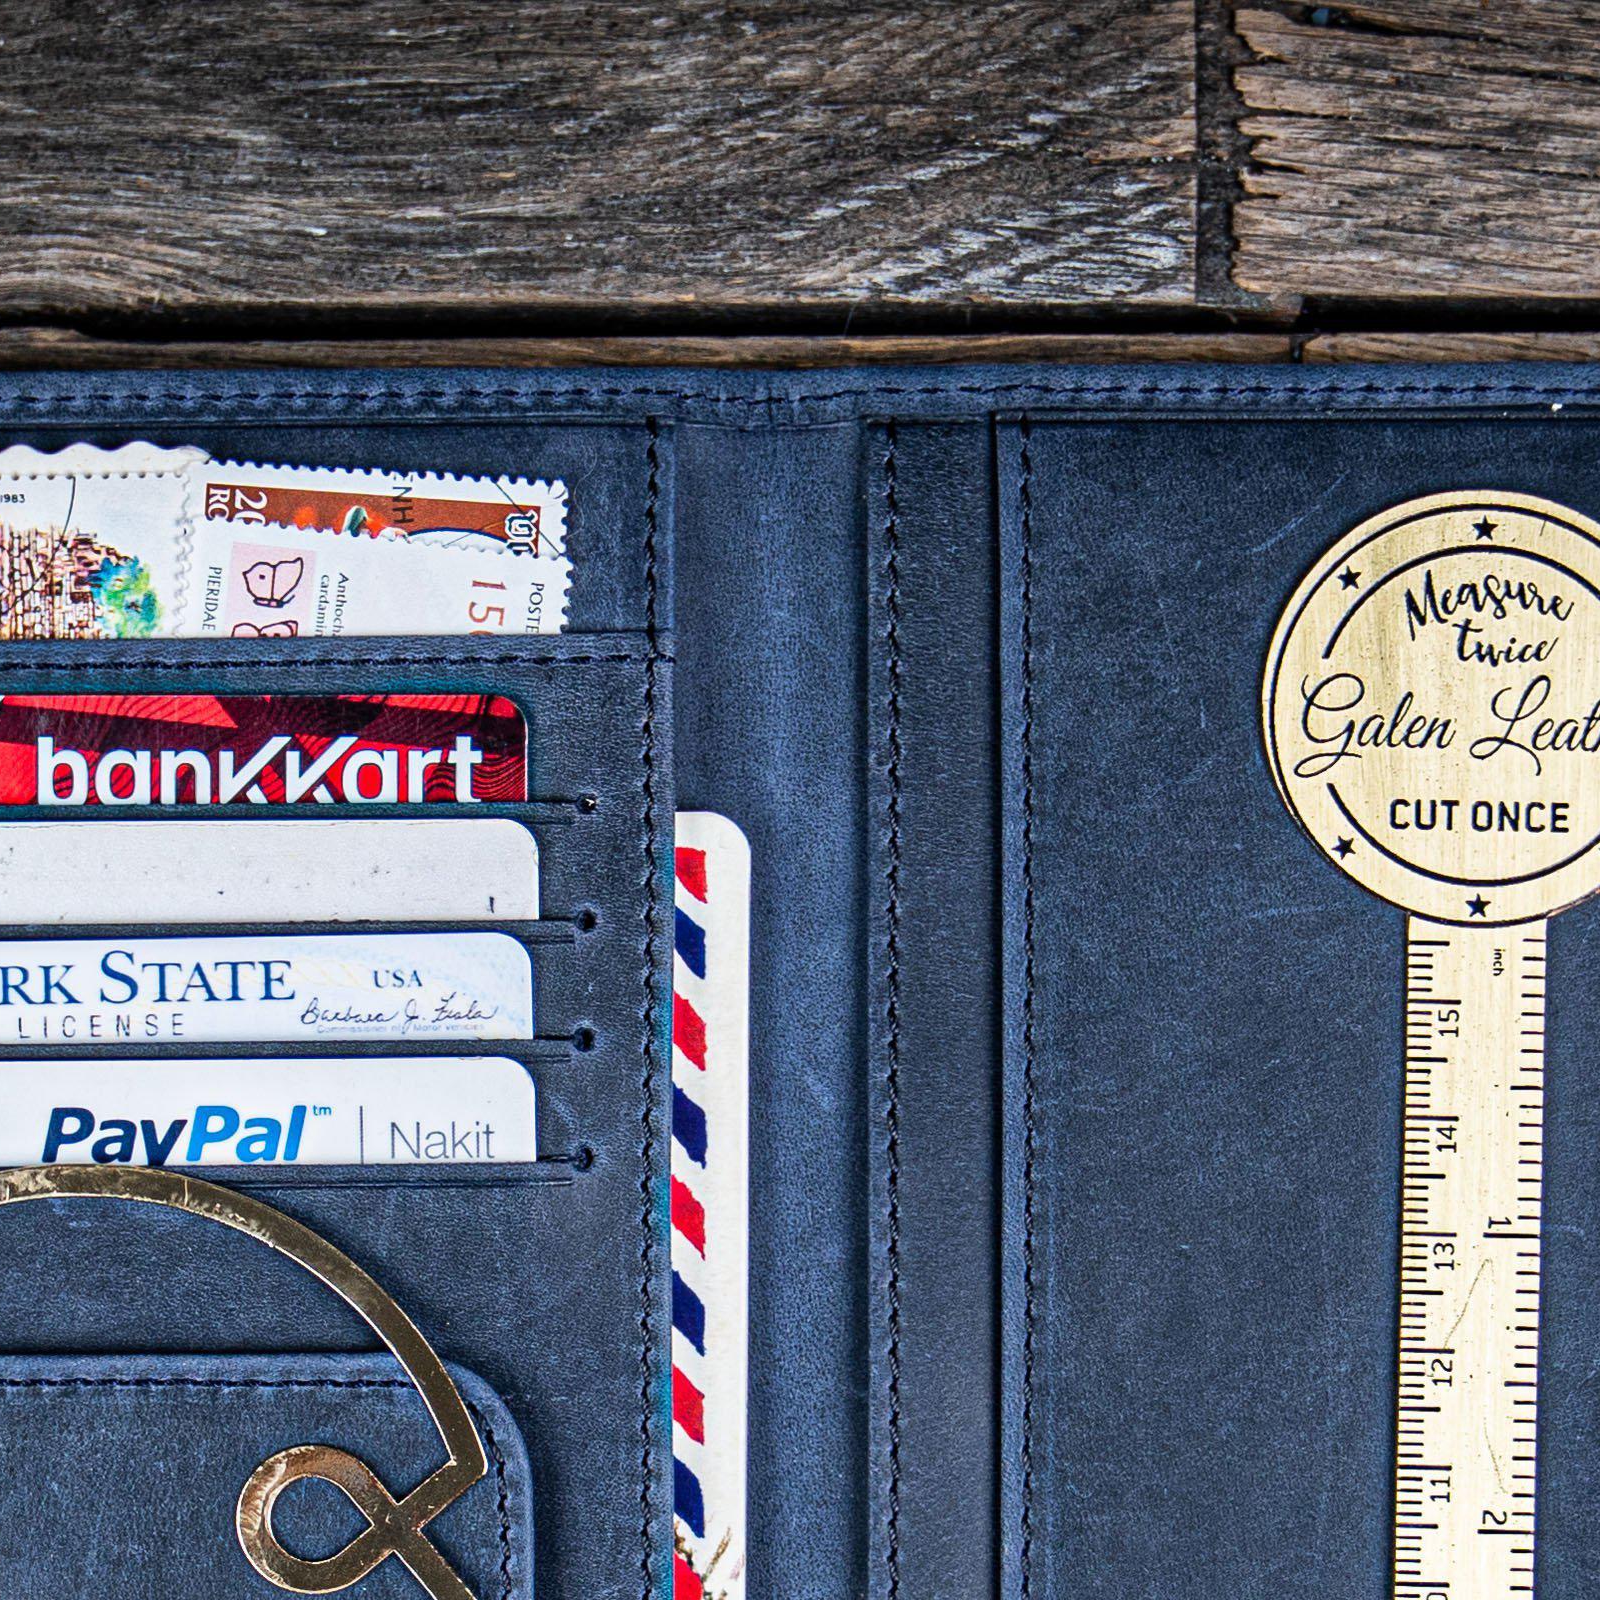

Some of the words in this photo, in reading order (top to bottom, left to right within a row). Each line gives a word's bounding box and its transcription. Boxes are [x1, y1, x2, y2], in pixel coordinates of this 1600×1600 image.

[201, 565, 223, 632] PIERIDAE
[467, 579, 508, 636] 15
[1404, 568, 1575, 642] Measure
[1451, 617, 1560, 668] twice
[1292, 671, 1458, 780] Galen
[1388, 798, 1460, 833] CUT
[1470, 800, 1571, 834] ONCE
[98, 949, 297, 1004] STATE
[1492, 948, 1506, 977] inch
[373, 969, 423, 989] USA
[17, 1011, 186, 1040] LICENSE
[1437, 1008, 1461, 1039] 15
[41, 1104, 307, 1165] PayPal
[390, 1119, 496, 1160] Nakit
[1435, 1124, 1458, 1154] 14
[1487, 1215, 1513, 1230] 1
[1432, 1241, 1456, 1271] 13
[1430, 1358, 1453, 1388] 12
[1429, 1475, 1451, 1504] 11
[1481, 1509, 1508, 1526] 2
